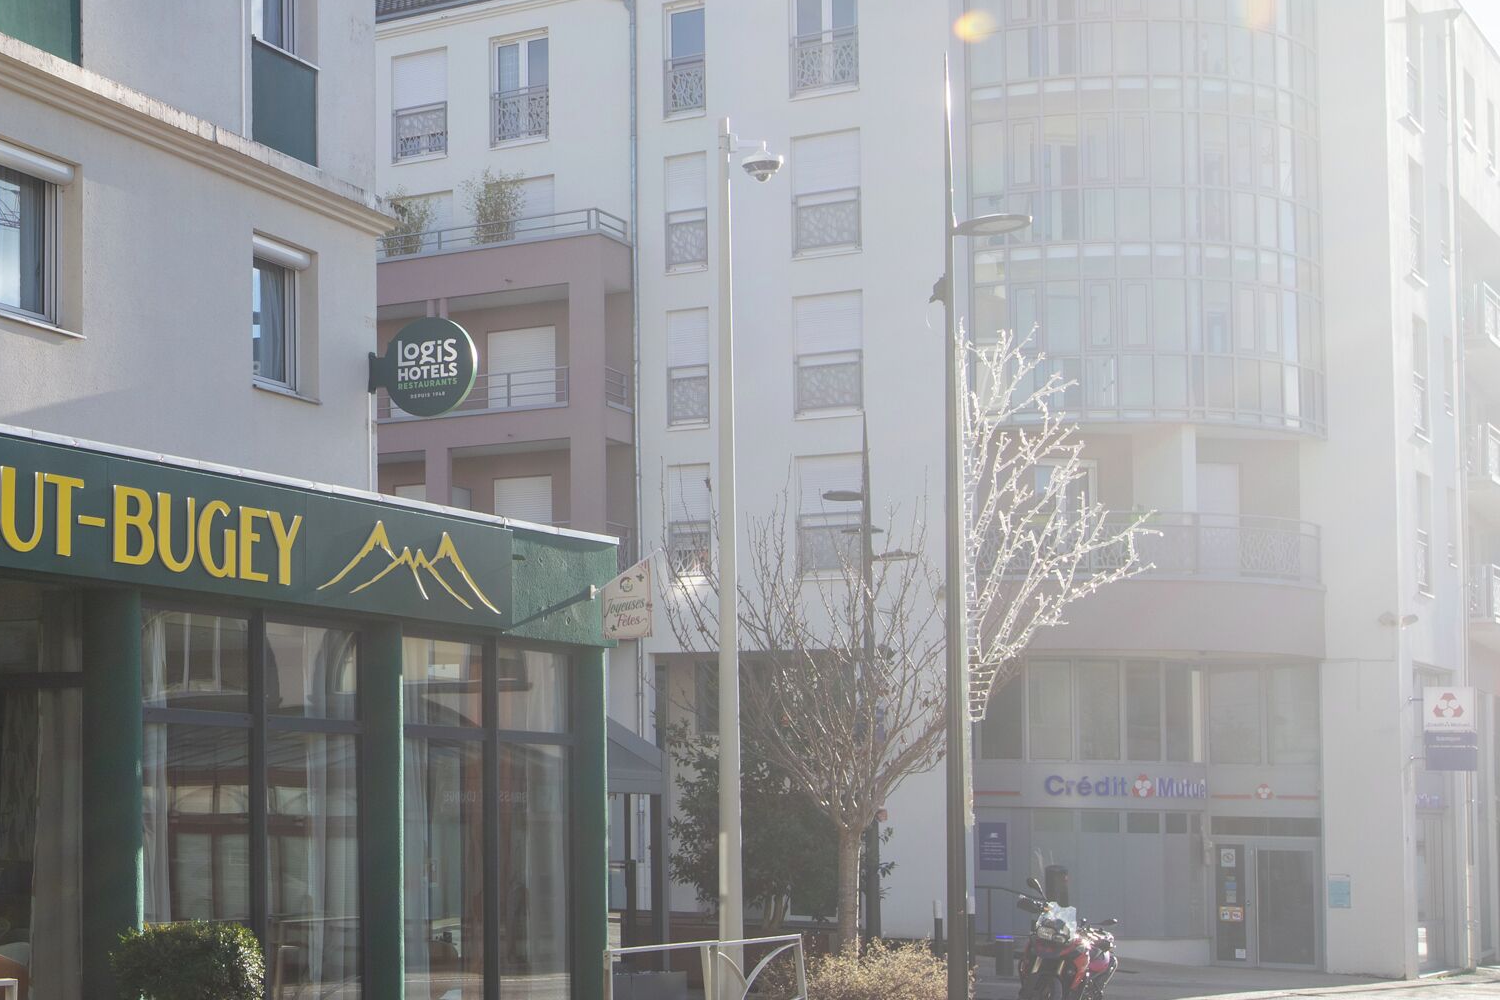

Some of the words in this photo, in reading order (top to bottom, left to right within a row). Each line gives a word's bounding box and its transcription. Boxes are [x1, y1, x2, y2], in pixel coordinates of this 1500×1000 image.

[397, 362, 458, 382] HOTELS
[397, 377, 458, 391] RESTAURANTS
[604, 598, 646, 618] Joyeuses
[1044, 775, 1128, 796] Crédit
